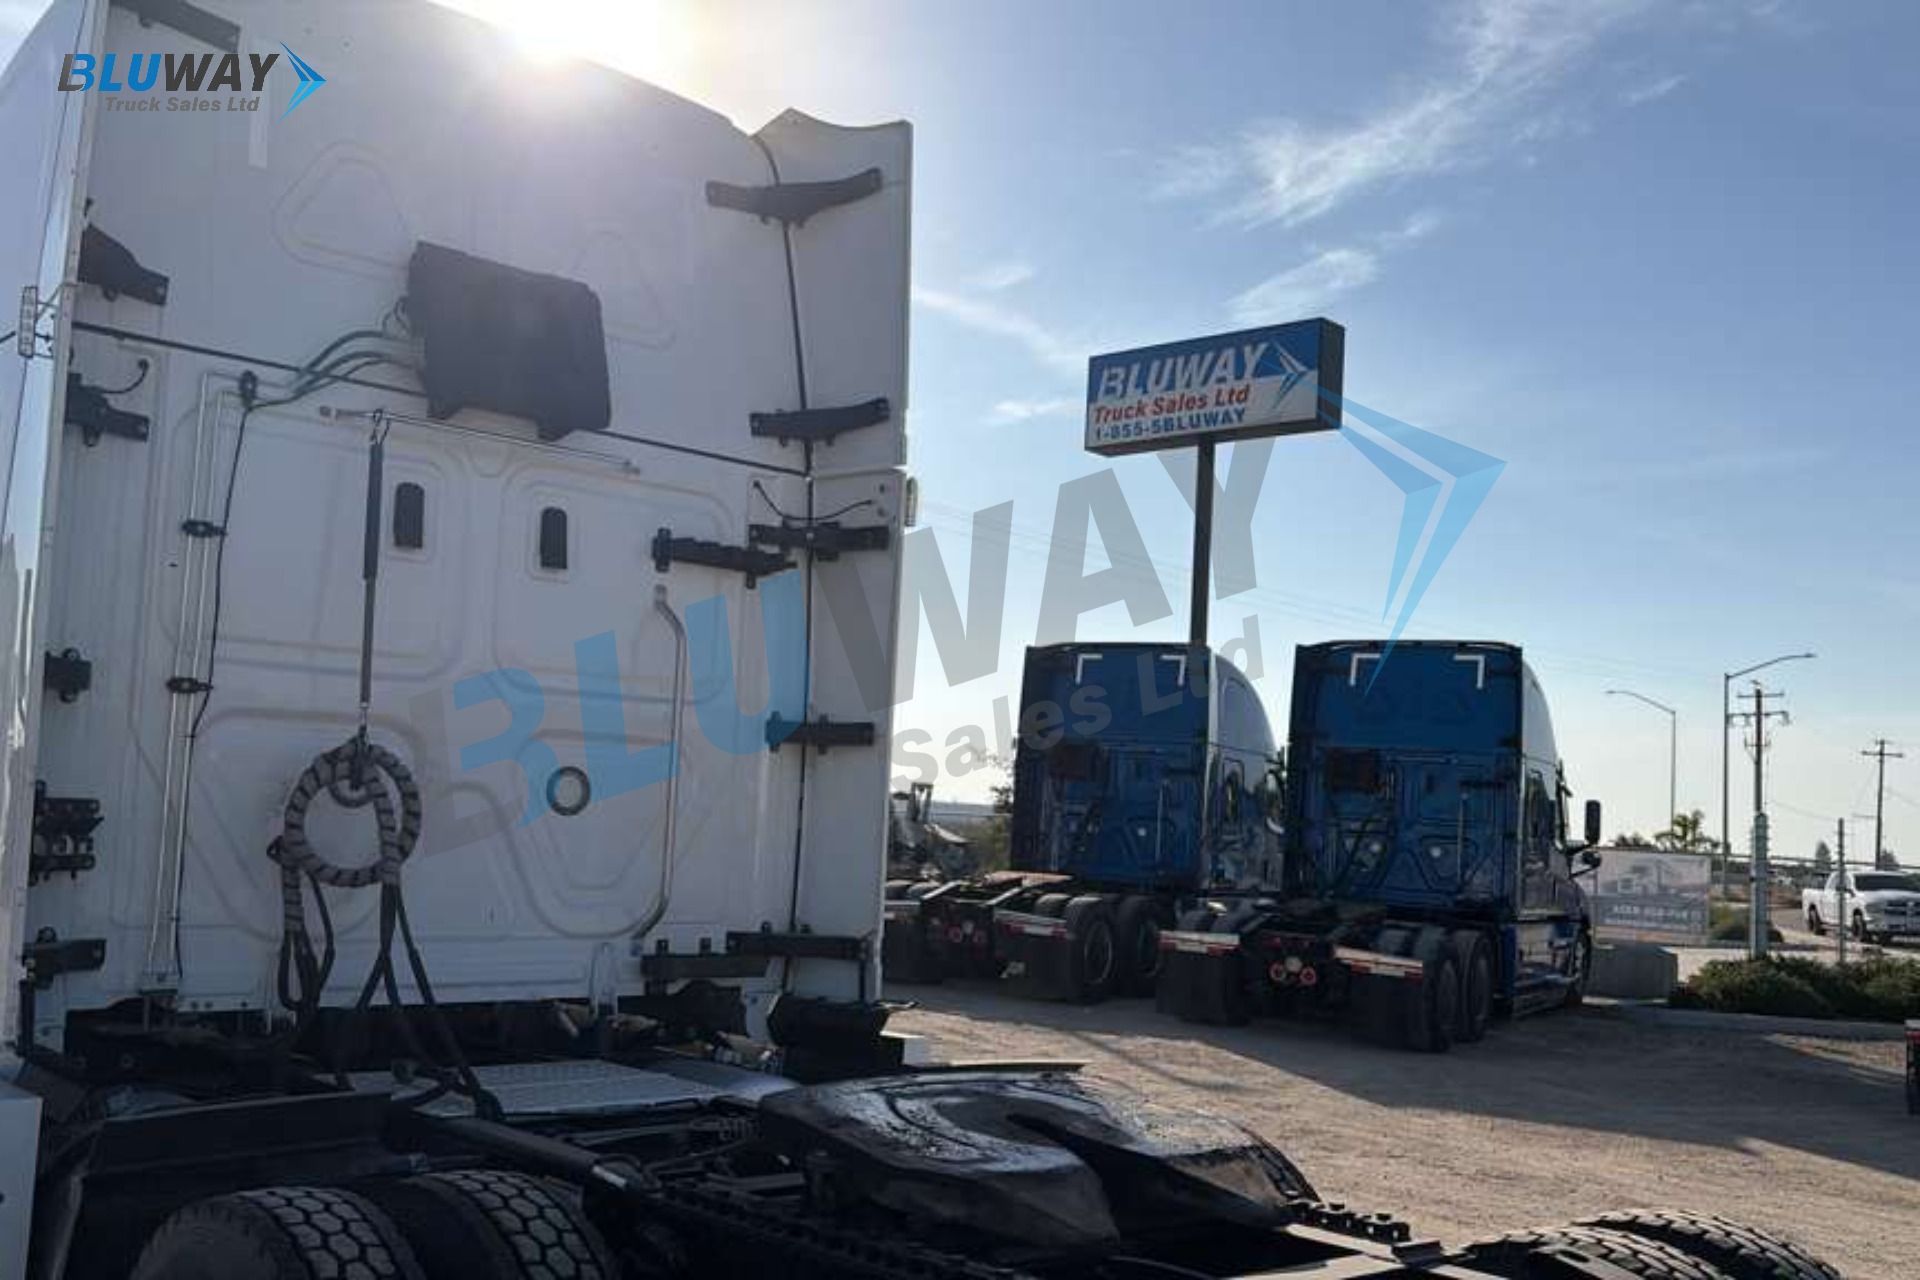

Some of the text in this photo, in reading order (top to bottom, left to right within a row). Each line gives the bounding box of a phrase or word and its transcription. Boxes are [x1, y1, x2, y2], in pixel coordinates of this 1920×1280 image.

[1098, 342, 1269, 400] BLUWAY
[1094, 383, 1251, 424] Truck Sales Ltd
[1096, 407, 1246, 440] 1-855-5BLUWAY
